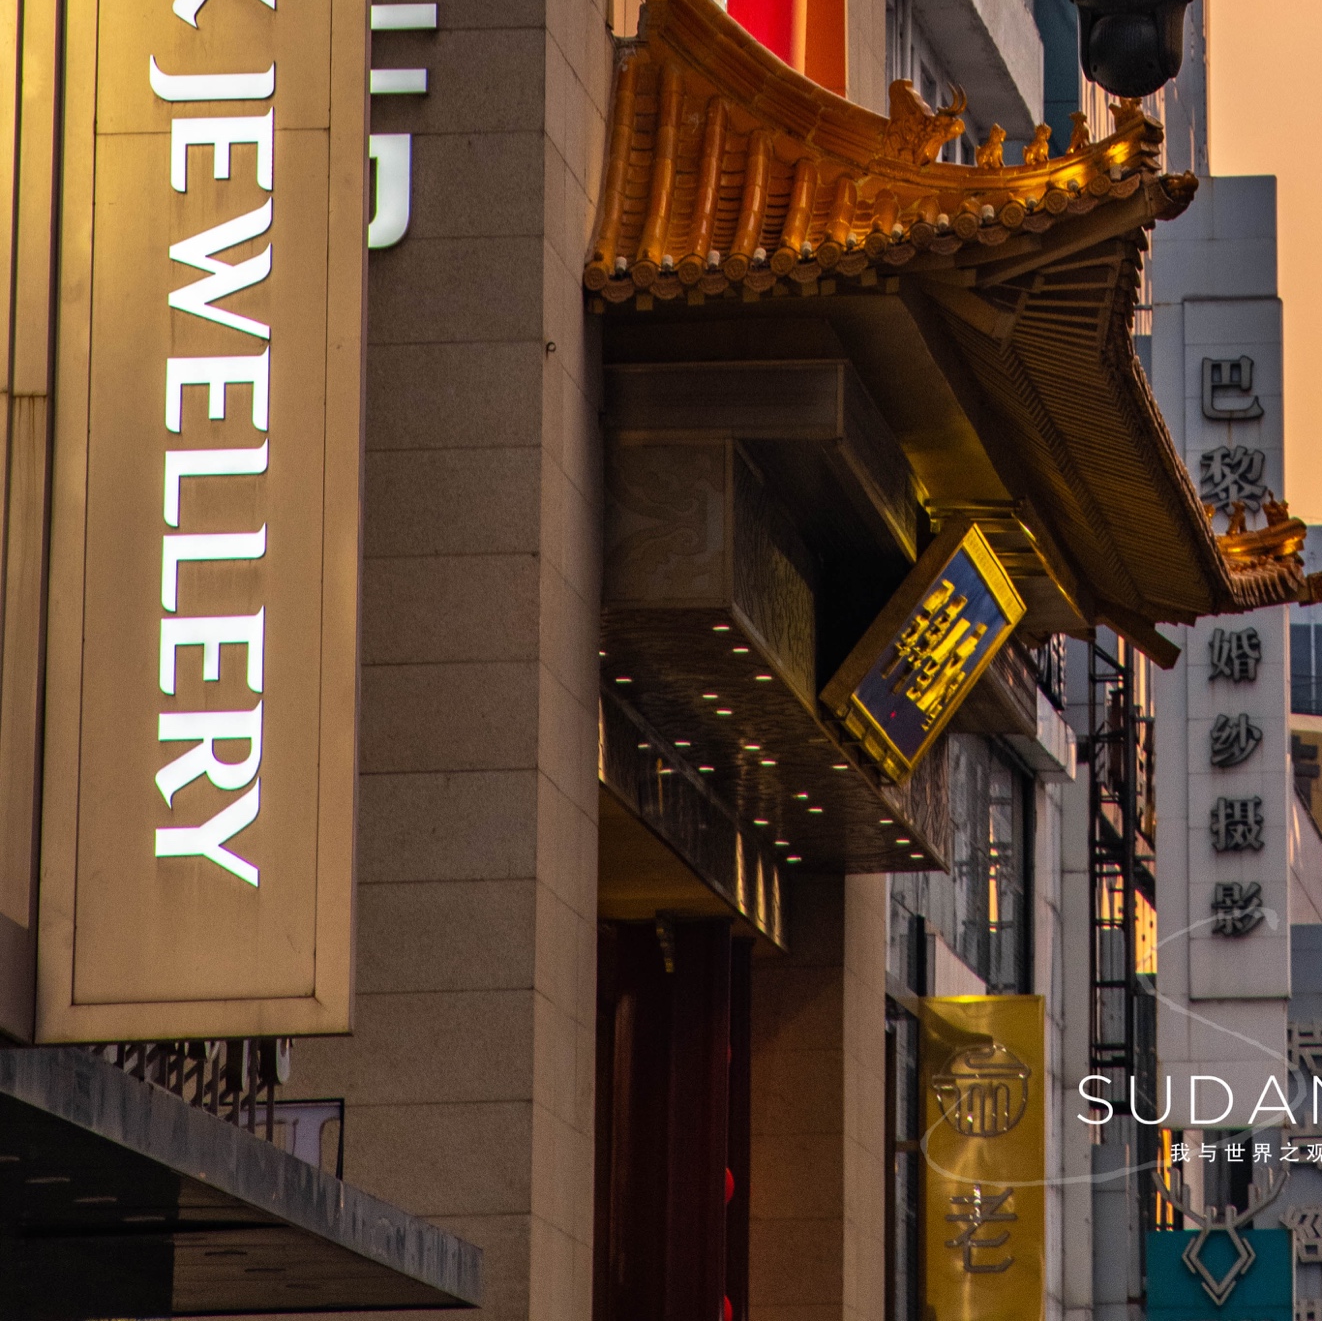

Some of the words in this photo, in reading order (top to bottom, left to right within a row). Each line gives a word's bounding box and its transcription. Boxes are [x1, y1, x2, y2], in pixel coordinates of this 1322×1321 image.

[149, 54, 276, 888] JEWELLERY
[1206, 626, 1265, 939] 婚纱摄影
